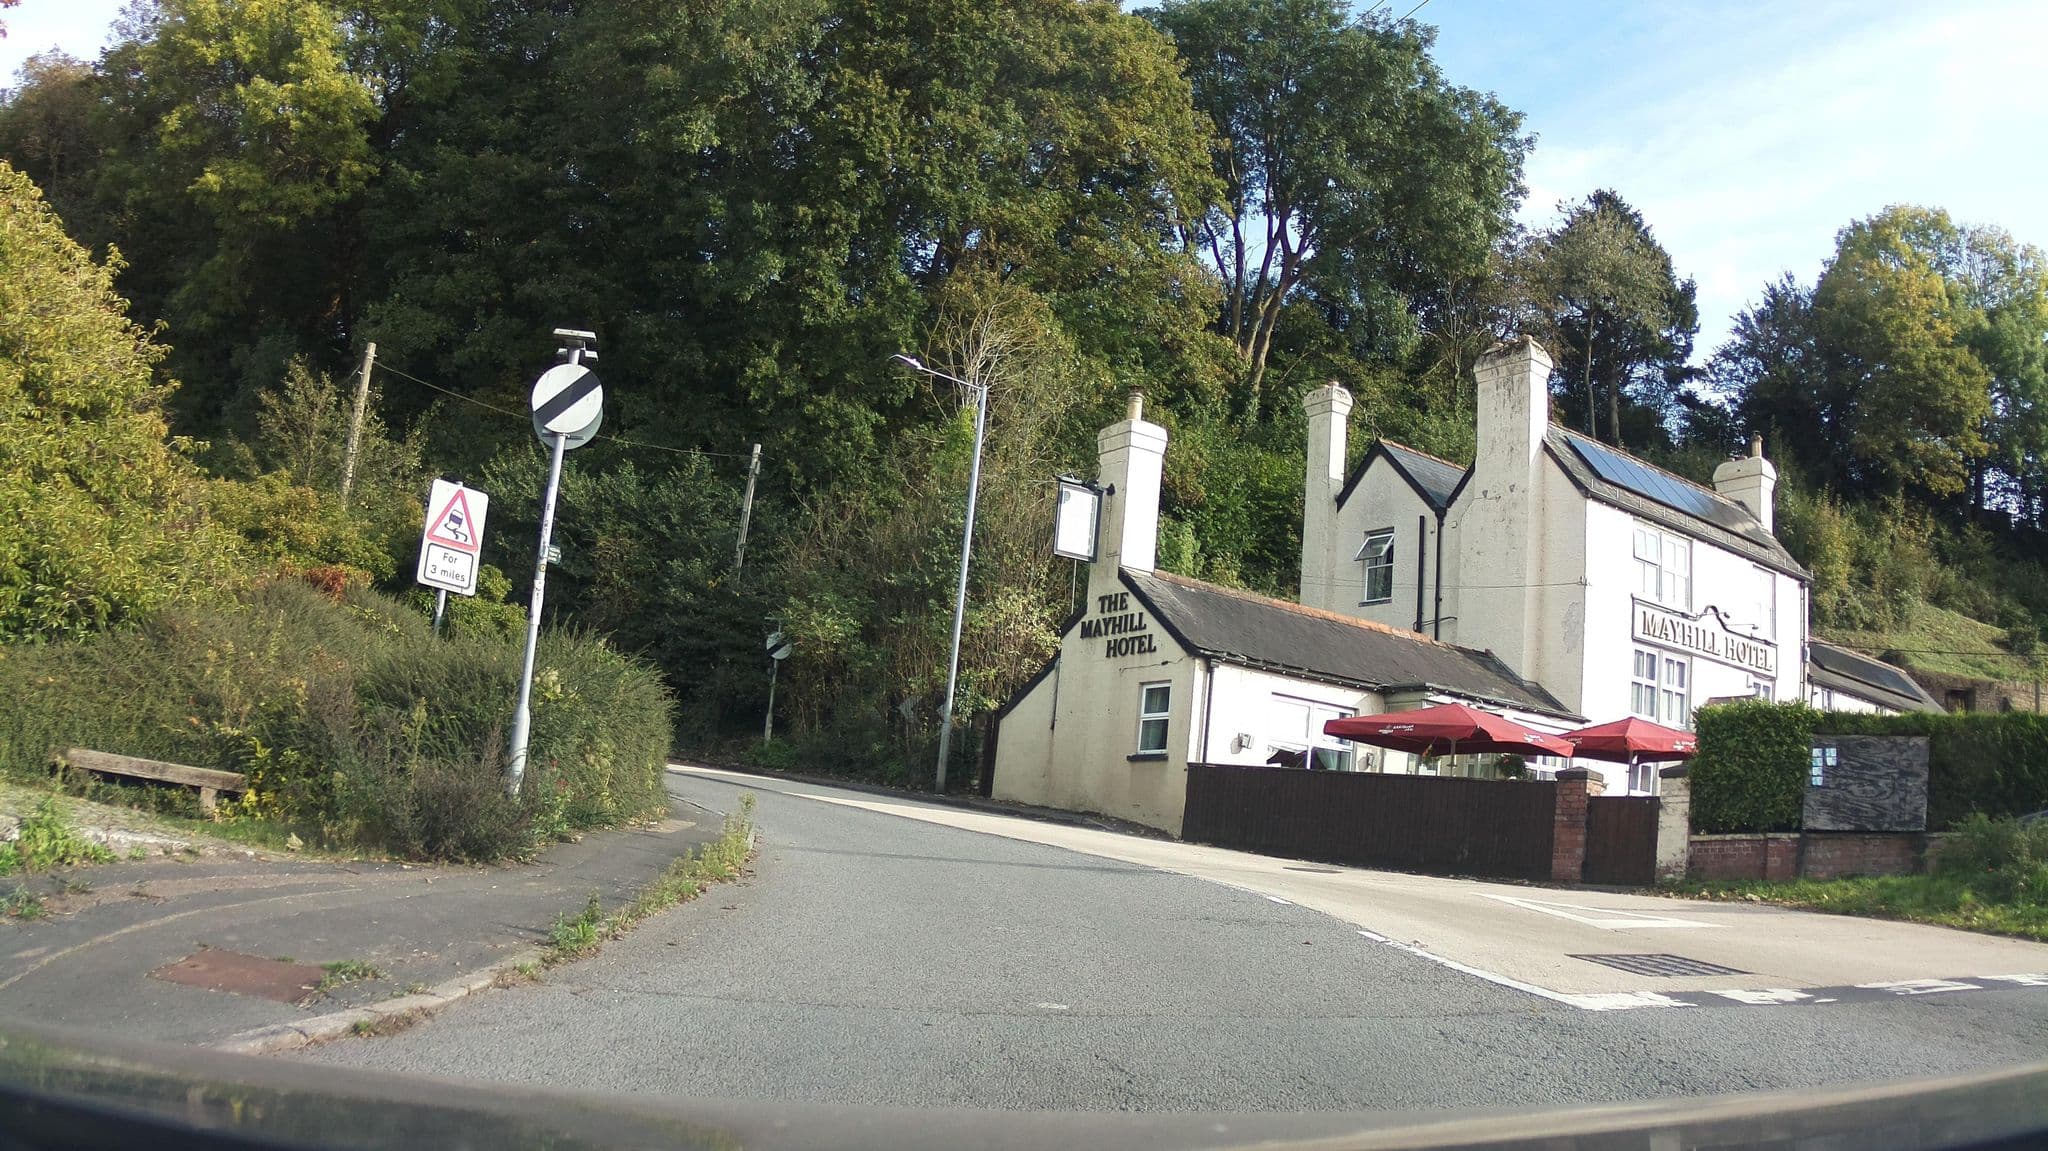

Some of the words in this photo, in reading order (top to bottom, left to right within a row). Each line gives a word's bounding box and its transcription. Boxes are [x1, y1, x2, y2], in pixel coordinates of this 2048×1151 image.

[443, 552, 458, 564] For
[430, 564, 437, 574] 3
[440, 569, 465, 582] miles
[1098, 592, 1129, 614] THE
[1080, 612, 1147, 639] MAYHILL
[1105, 633, 1157, 658] HOTEL
[1642, 610, 1721, 656] MAYHILL
[1725, 636, 1773, 672] HOTEL
